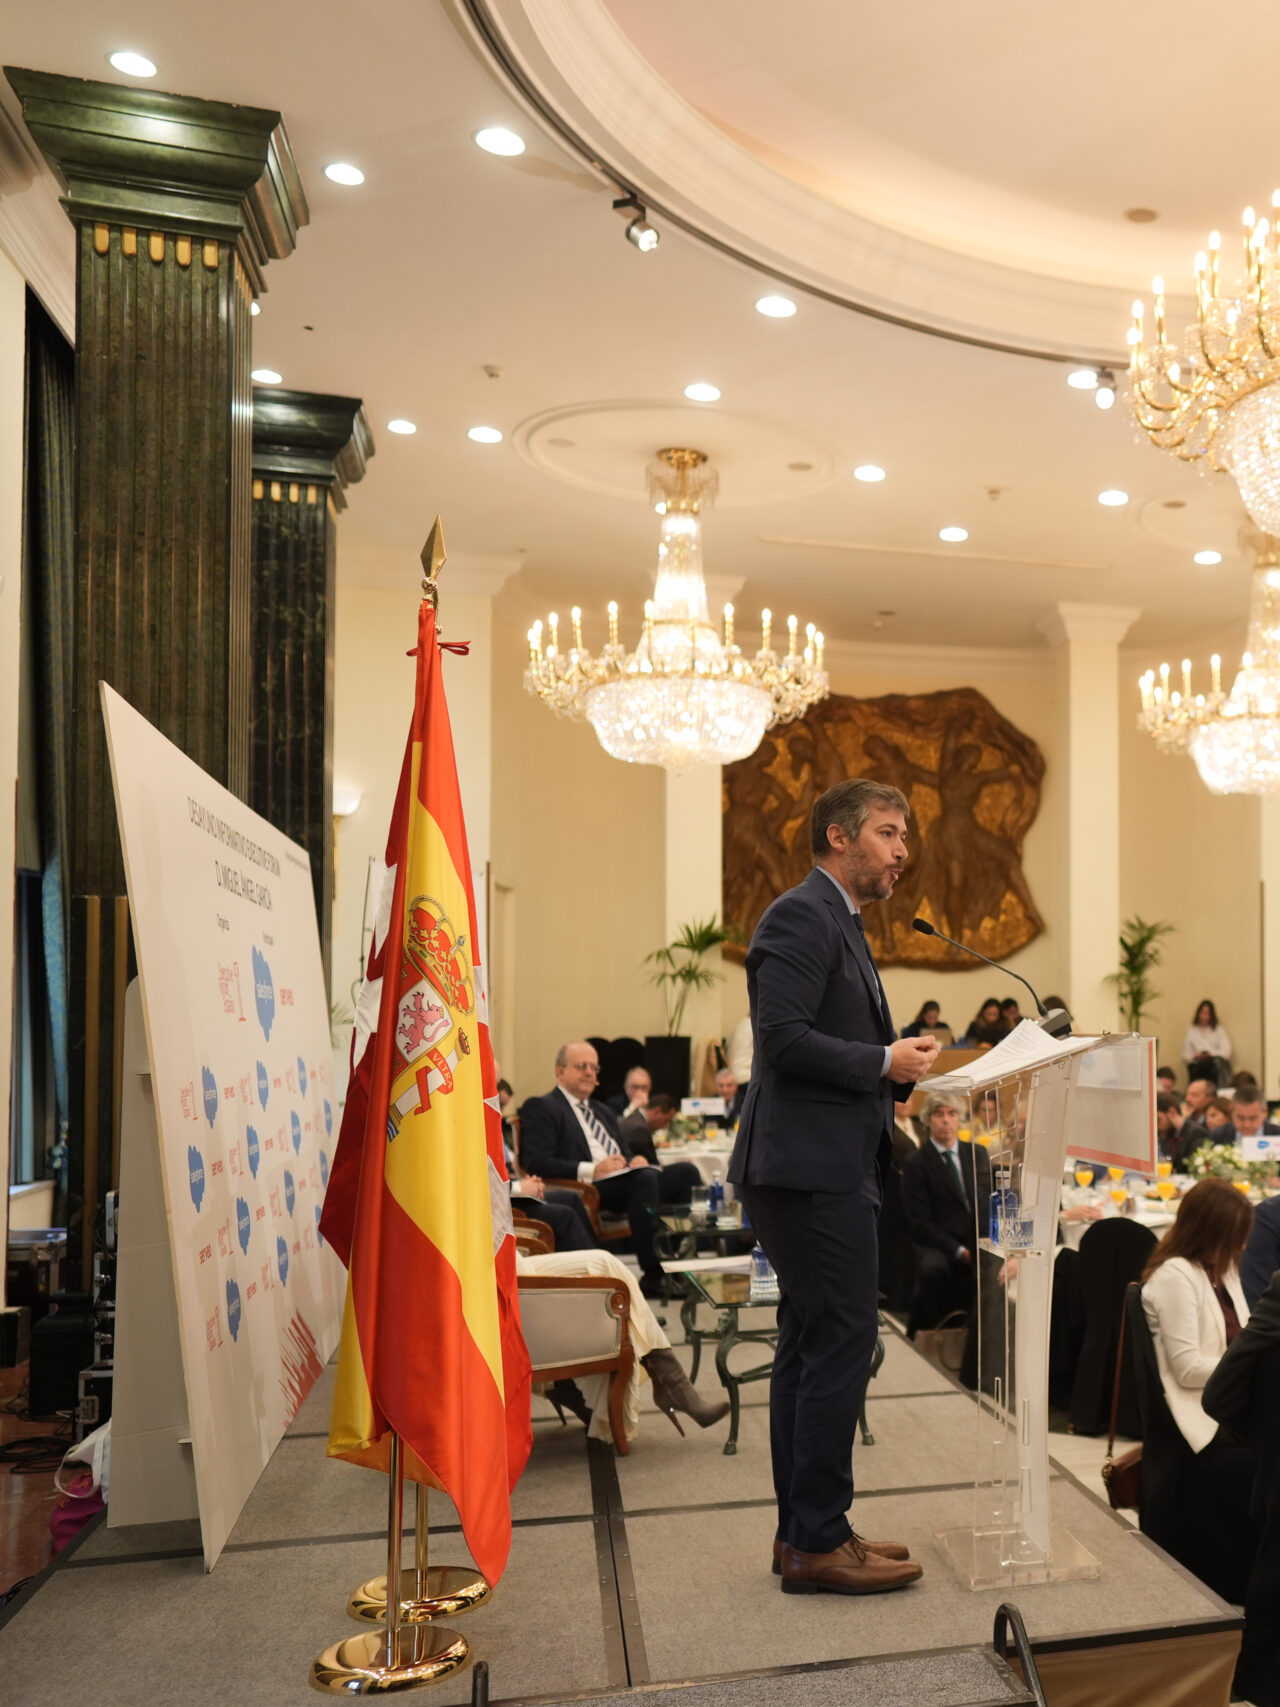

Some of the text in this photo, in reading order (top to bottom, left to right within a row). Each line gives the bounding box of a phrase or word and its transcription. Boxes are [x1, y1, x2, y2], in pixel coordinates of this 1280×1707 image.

[187, 795, 217, 839] DESAYUNO
[216, 817, 247, 858] INFORMATIVO
[221, 863, 241, 896] MIGUEL
[432, 1052, 452, 1089] VLTRA
